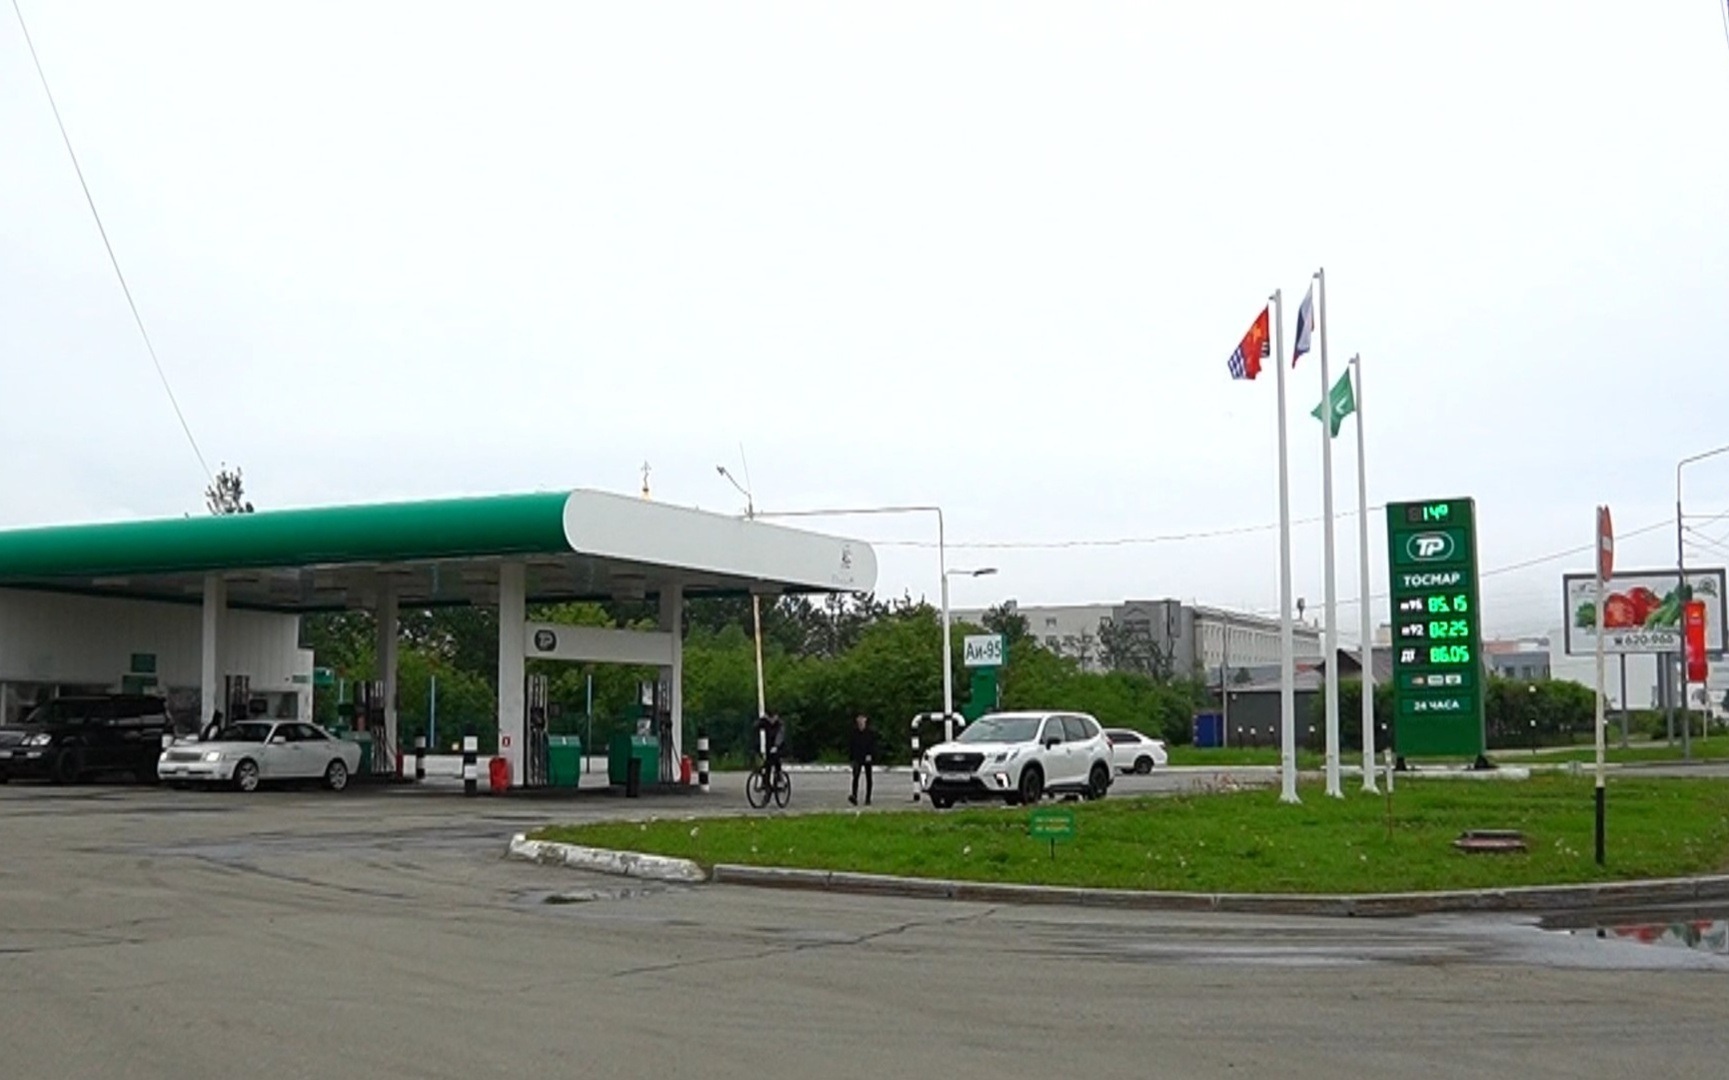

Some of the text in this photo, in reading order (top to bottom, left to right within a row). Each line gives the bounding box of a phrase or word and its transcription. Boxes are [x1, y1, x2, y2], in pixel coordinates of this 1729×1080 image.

[1404, 572, 1460, 587] ТОСМАР
[1414, 699, 1460, 711] 24 ЧАСА
